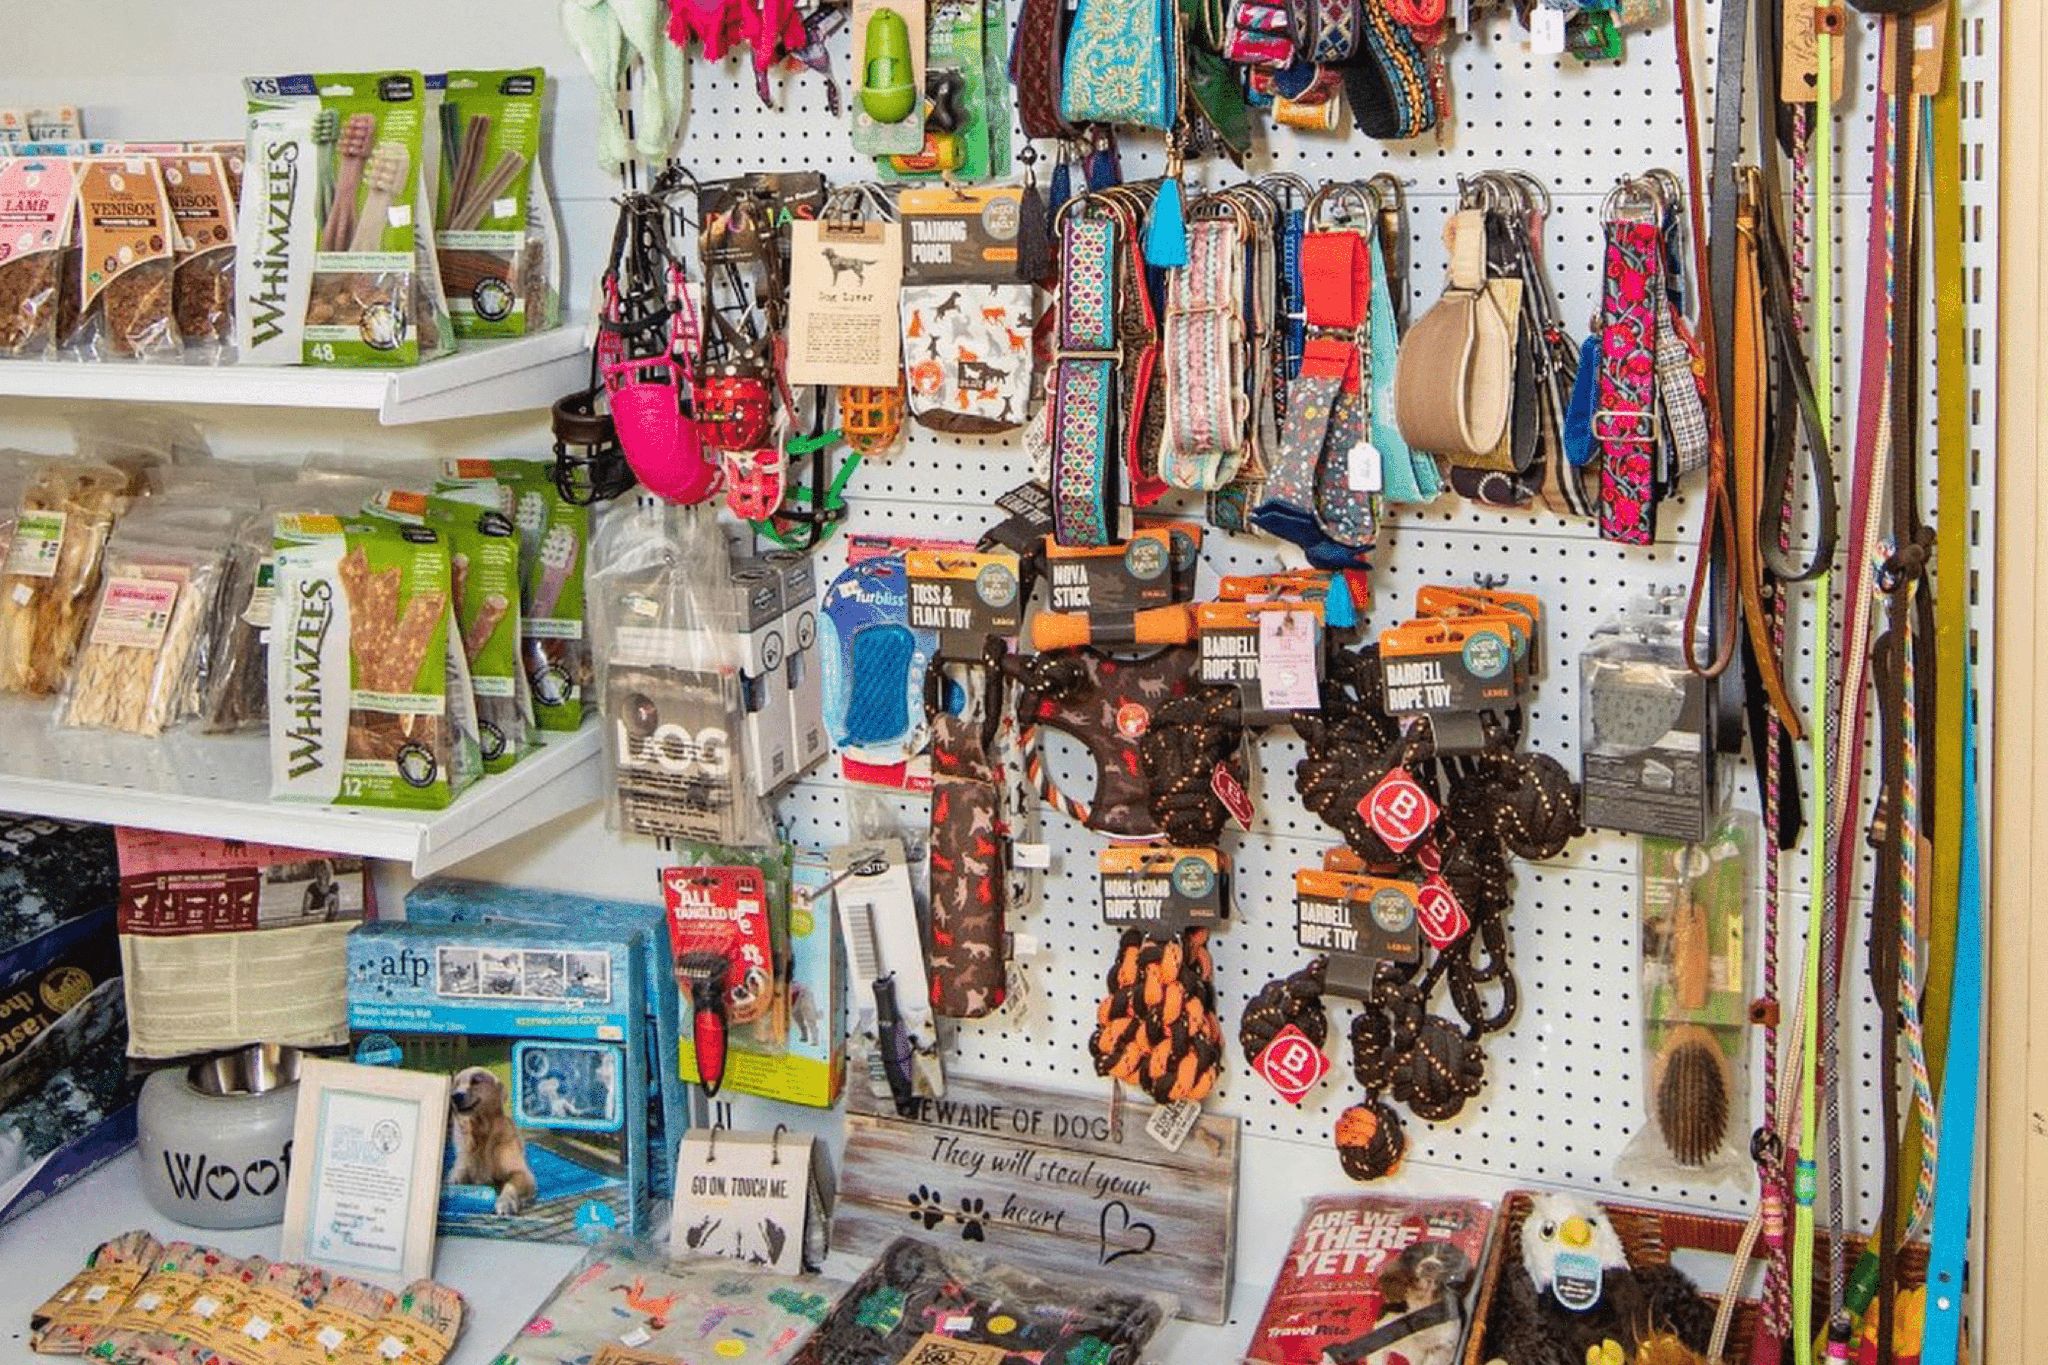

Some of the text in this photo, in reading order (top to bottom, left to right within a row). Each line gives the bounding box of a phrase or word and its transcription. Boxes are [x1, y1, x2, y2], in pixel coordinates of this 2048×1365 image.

[251, 79, 277, 94] XS
[4, 199, 50, 211] LAMB
[91, 203, 156, 216] VENISON
[170, 194, 218, 208] NISON
[911, 221, 967, 242] TRAINING
[911, 244, 952, 264] POUCH
[311, 343, 334, 360] 48
[1053, 565, 1088, 585] NOVA
[856, 590, 906, 607] furbliss
[911, 584, 953, 606] TOSS &
[1053, 586, 1091, 608] STICK
[912, 606, 972, 629] FLOAT TOY
[1202, 636, 1258, 657] BARBELL
[1203, 659, 1236, 680] ROPE
[1386, 661, 1445, 686] BARBELL
[1389, 684, 1452, 711] ROPE TOY
[1389, 789, 1418, 822] B
[680, 889, 715, 907] ALL
[1104, 880, 1171, 898] HONEYCOMB
[673, 906, 728, 920] TANGLED
[1107, 899, 1162, 919] ROPE TOY
[1300, 902, 1352, 927] BARBELL
[1430, 895, 1450, 921] B
[1300, 924, 1358, 951] ROPE TOY
[382, 949, 430, 987] afp
[1284, 1045, 1308, 1073] B
[908, 1098, 1002, 1131] EWARE
[1012, 1107, 1042, 1136] OF
[932, 1136, 1152, 1201] They will steal your
[691, 1176, 707, 1196] GO
[731, 1177, 767, 1198] TOUCH
[590, 1204, 600, 1221] L
[1001, 1193, 1064, 1231] heart
[1309, 1211, 1360, 1231] ARE
[1362, 1210, 1406, 1228] WE
[1303, 1225, 1422, 1255] THERE
[1294, 1250, 1387, 1278] YET?
